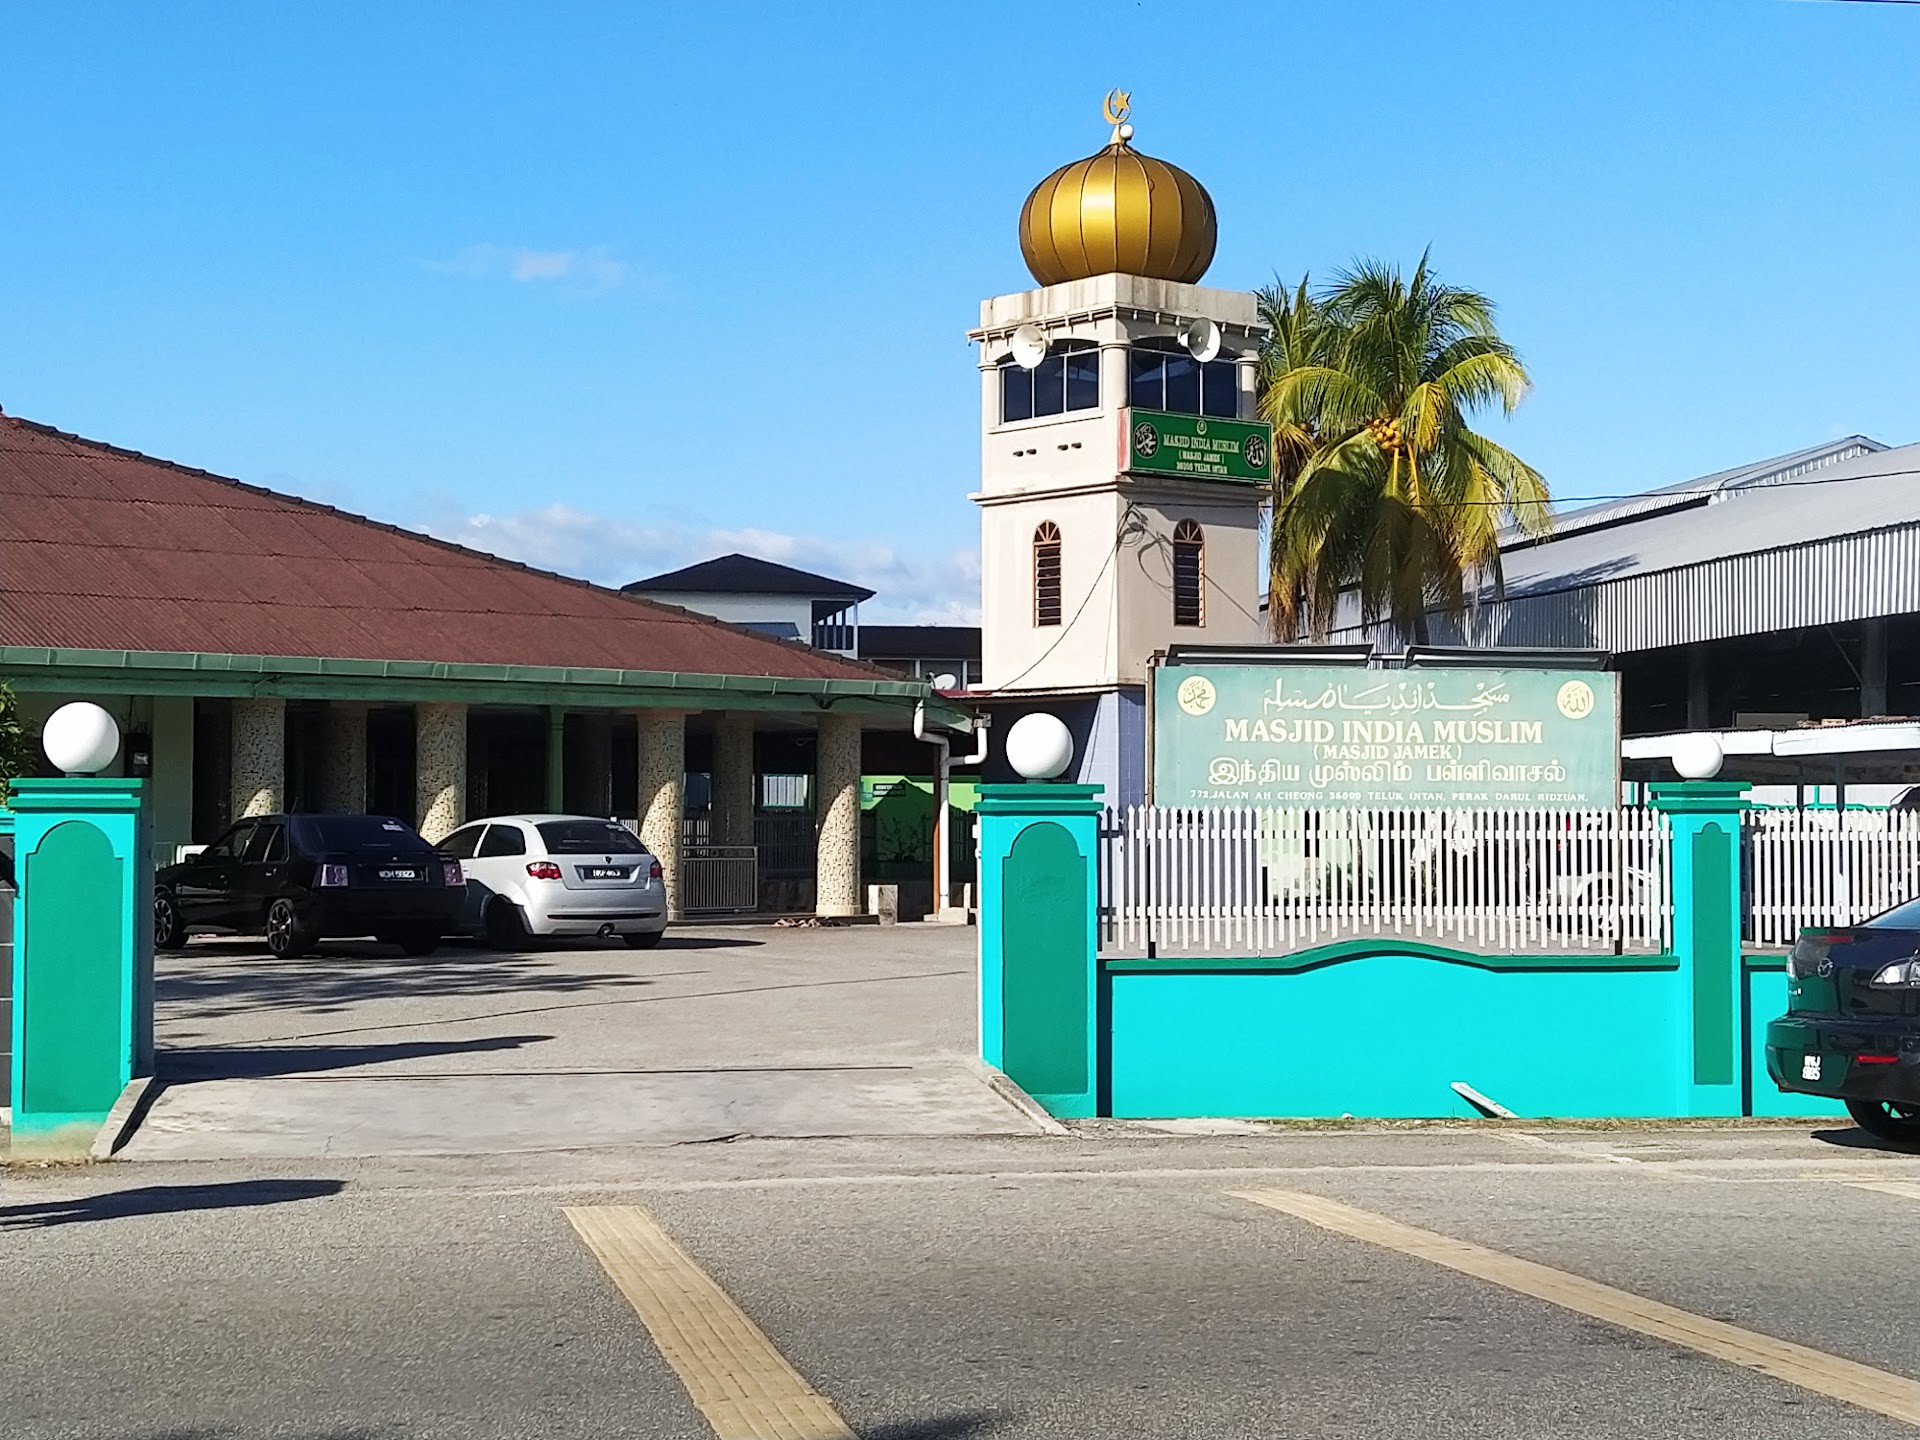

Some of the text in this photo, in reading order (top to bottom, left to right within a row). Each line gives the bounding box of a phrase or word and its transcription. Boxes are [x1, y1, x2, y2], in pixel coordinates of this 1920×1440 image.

[1163, 434, 1239, 453] MASJID INDIA MUSLIM
[1225, 718, 1543, 744] MASJID INDIA MUSLIM
[1208, 757, 1566, 789] இந்திய முஸ்லிம் பள்ளிவாசல்
[1255, 791, 1271, 800] AH
[1277, 791, 1323, 800] CHEONG
[1329, 791, 1361, 800] 36000
[1368, 791, 1403, 800] TELUK
[1451, 792, 1488, 800] PERAK
[1495, 792, 1531, 801] DARUL
